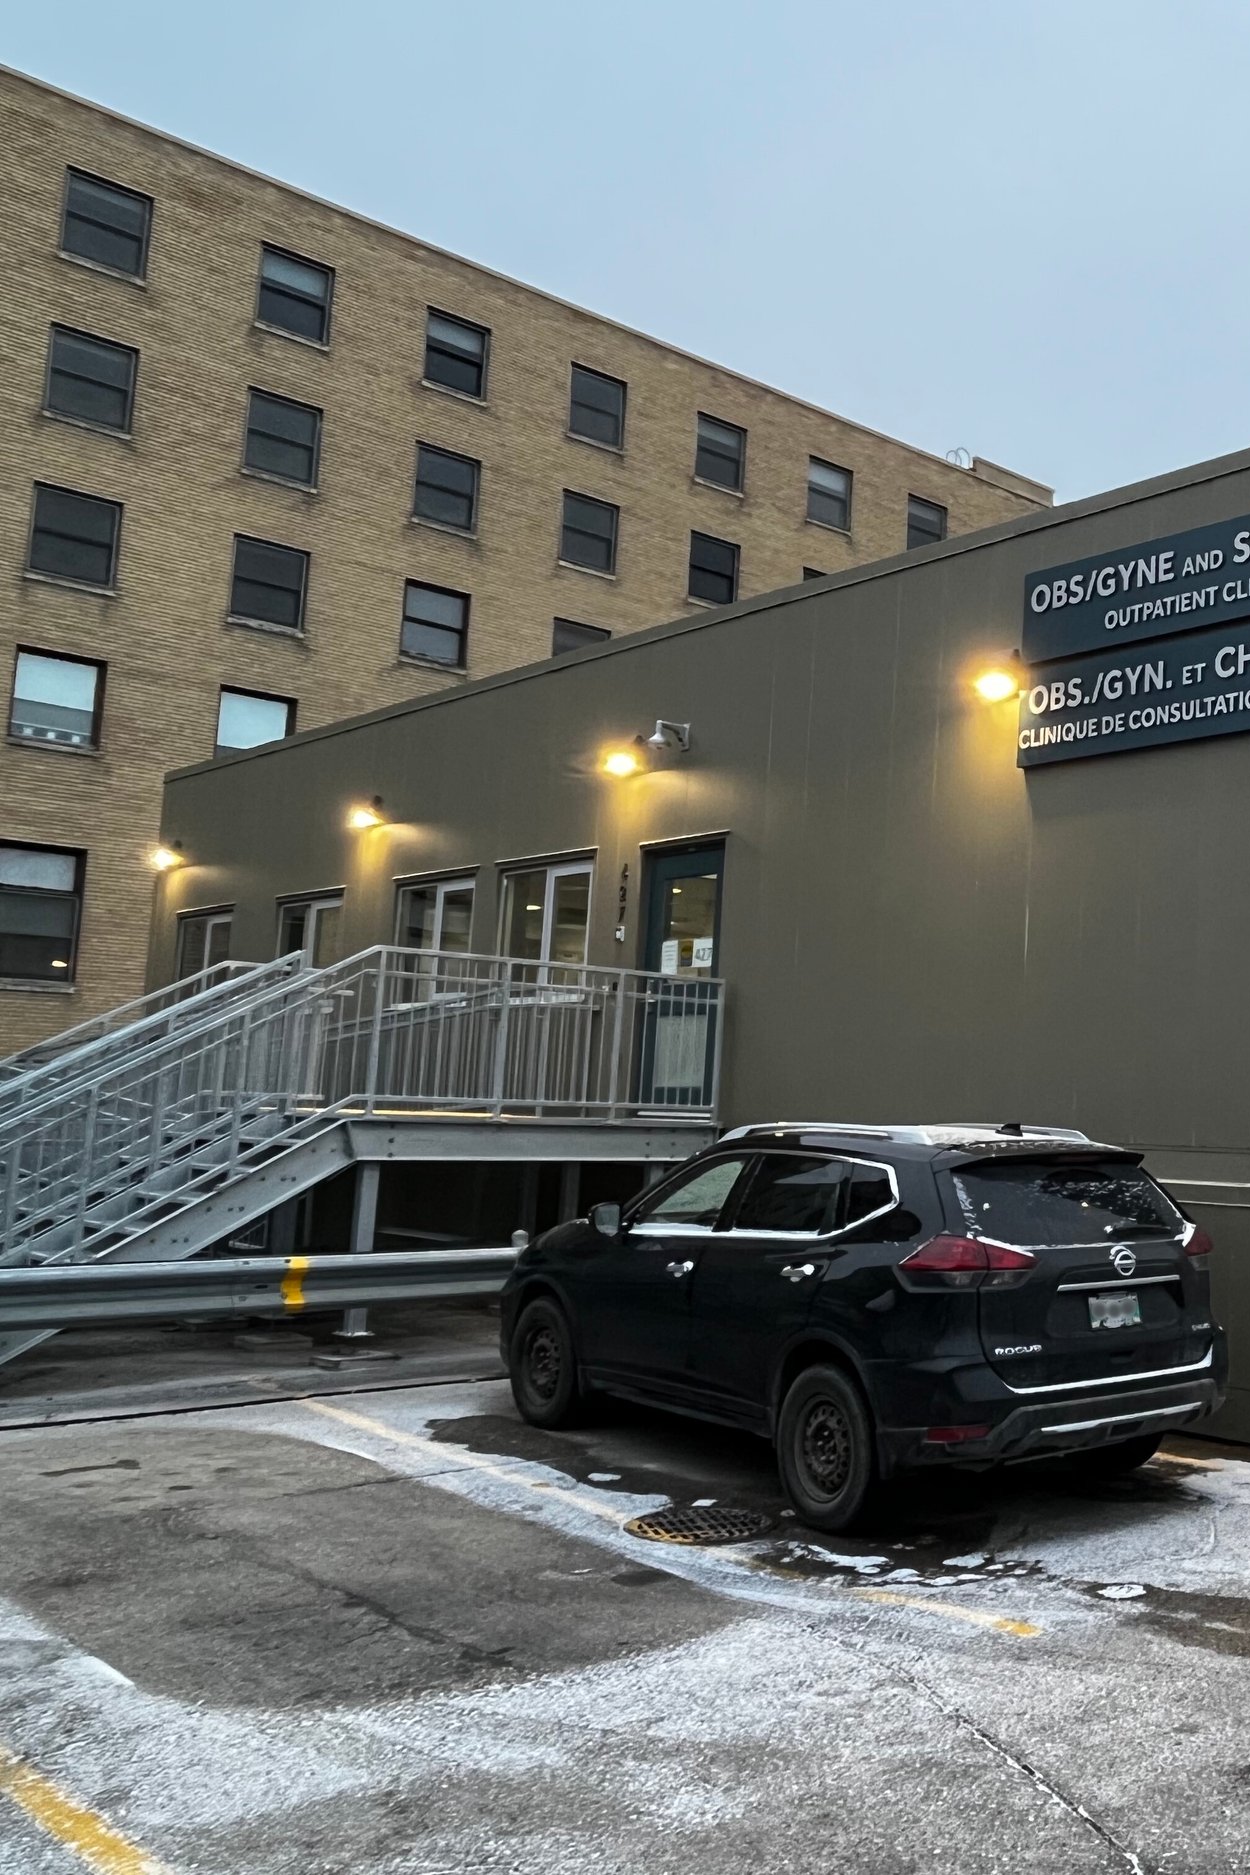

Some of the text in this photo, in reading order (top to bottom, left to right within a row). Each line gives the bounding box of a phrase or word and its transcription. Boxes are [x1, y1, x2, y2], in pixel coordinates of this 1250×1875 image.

[1031, 551, 1175, 613] OBS/GYNE
[1182, 549, 1223, 577] AND
[1104, 586, 1218, 630] OUTPATIENT
[1028, 660, 1173, 715] OBS./GYN.
[1182, 663, 1206, 686] ET
[1018, 719, 1098, 750] CLINIQUE
[1102, 714, 1125, 735] DE
